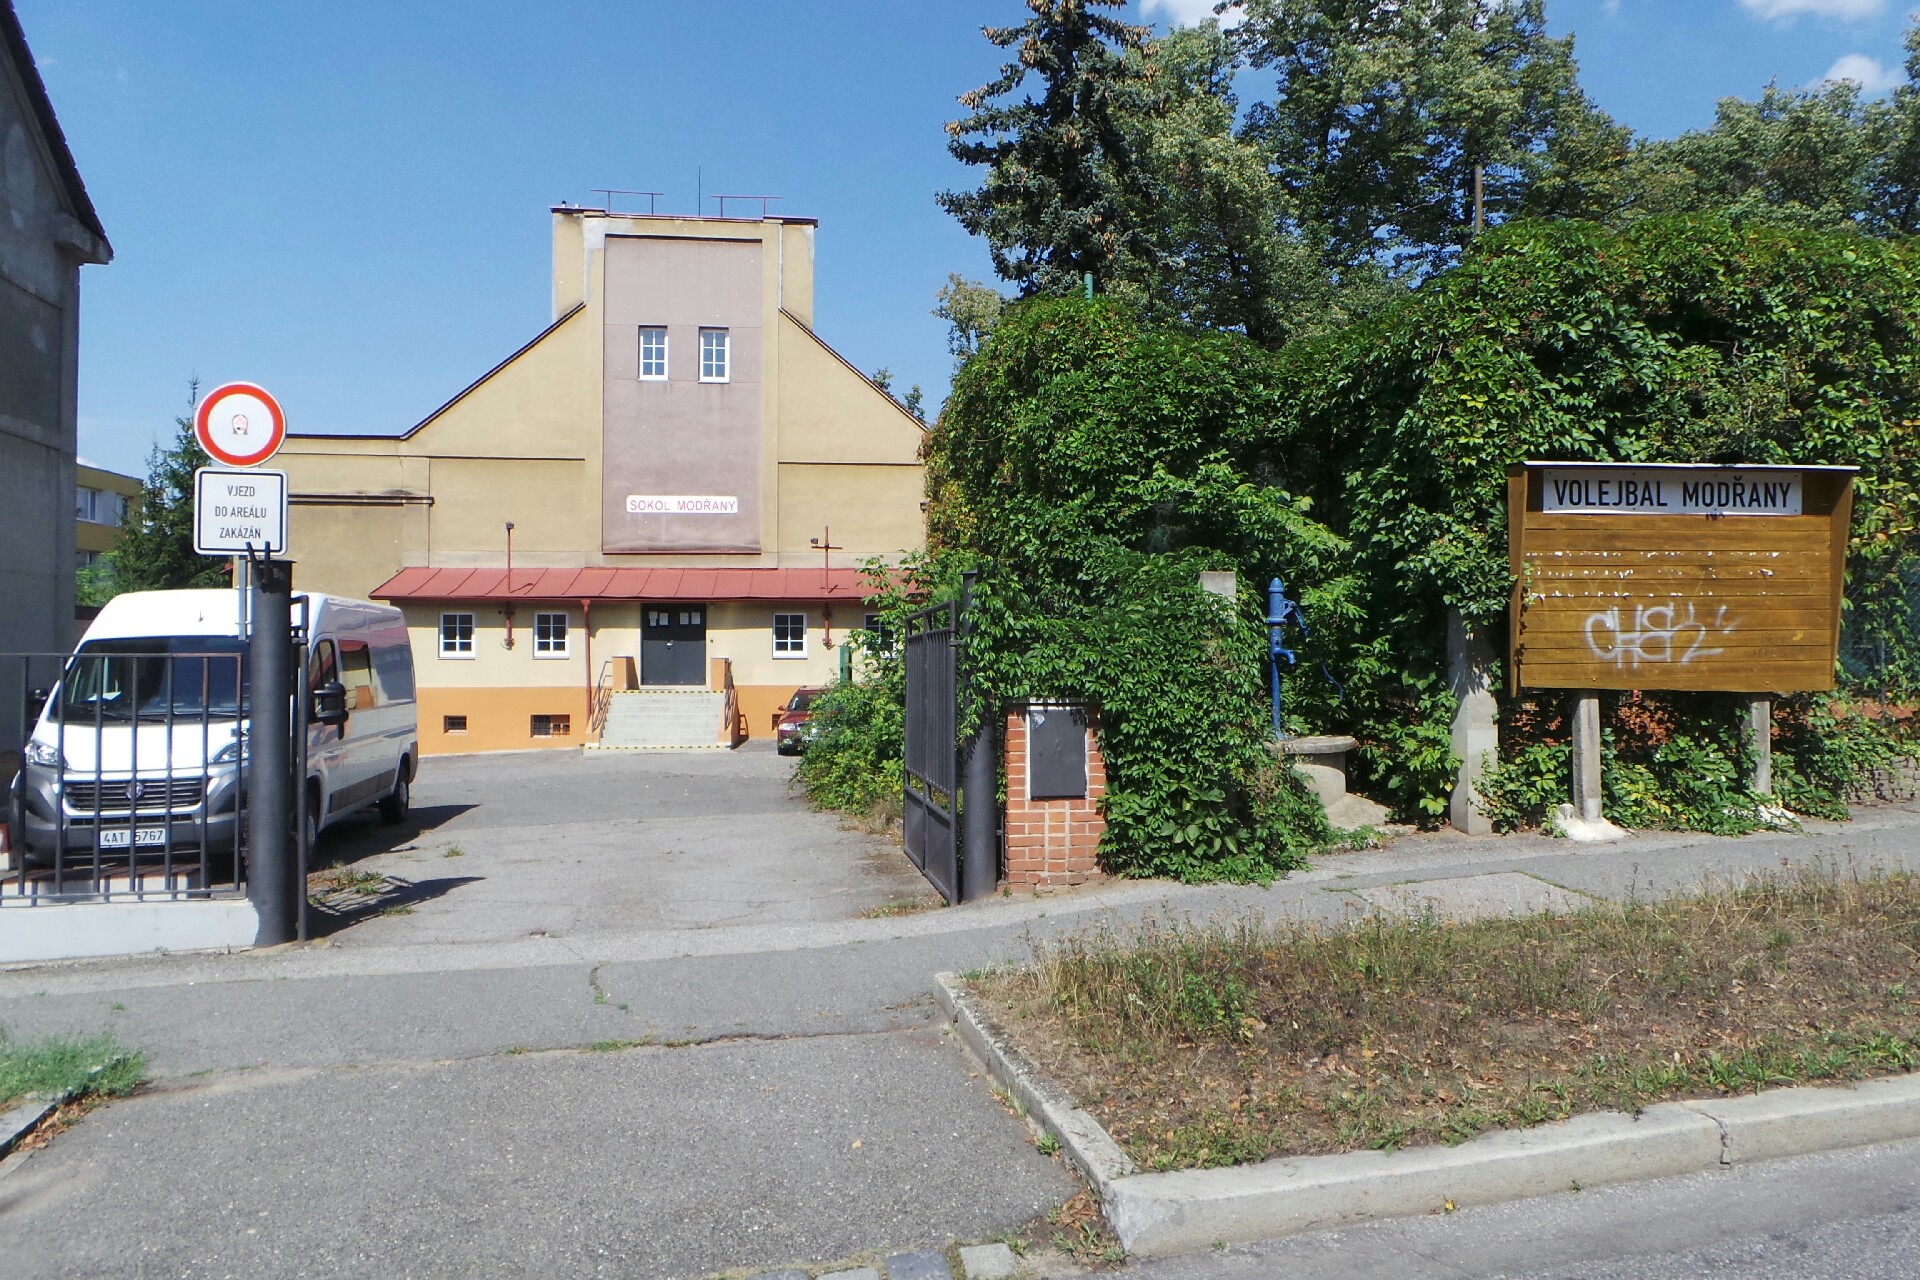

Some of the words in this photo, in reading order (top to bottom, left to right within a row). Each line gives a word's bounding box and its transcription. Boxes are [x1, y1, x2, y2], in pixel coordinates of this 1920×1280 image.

[227, 485, 256, 497] VJEZD
[1554, 479, 1668, 507] VOLEJBAL
[1682, 475, 1792, 508] MODŘANY
[214, 505, 228, 517] DO
[230, 503, 267, 519] AREÁLU
[630, 499, 670, 511] SOKOL
[677, 498, 736, 511] MODŘANY
[219, 524, 261, 539] ZAKÁZÁN
[104, 832, 126, 844] 4AT
